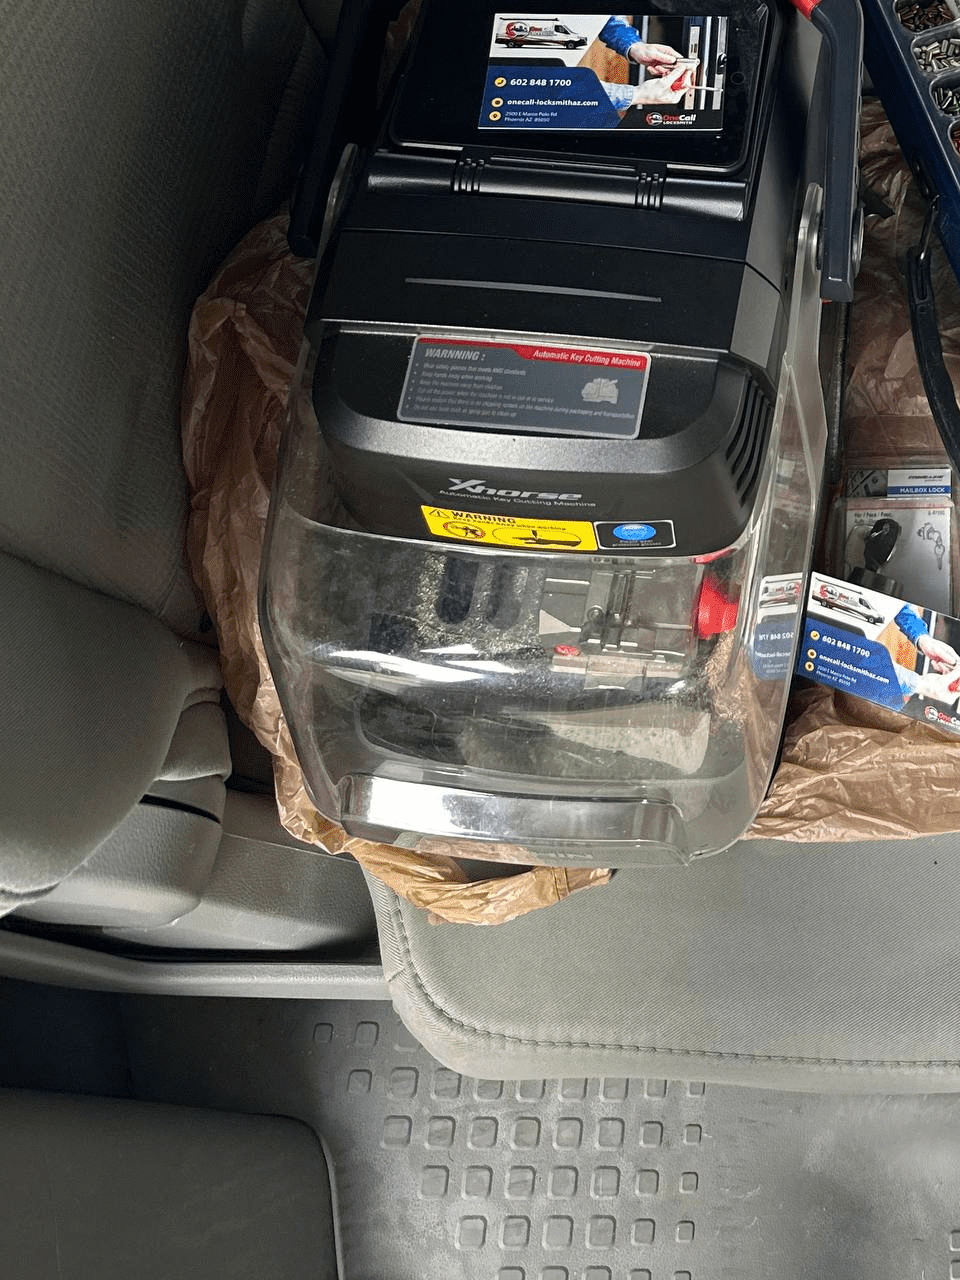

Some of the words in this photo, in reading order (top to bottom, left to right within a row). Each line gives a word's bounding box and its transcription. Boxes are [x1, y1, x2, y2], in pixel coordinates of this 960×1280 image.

[424, 347, 480, 361] WARNNING
[532, 349, 569, 361] Automatic
[569, 353, 584, 364] Key
[584, 353, 610, 366] Cutting
[611, 357, 641, 368] Machine
[439, 489, 491, 501] Automatic
[493, 496, 511, 505] Key
[513, 497, 552, 507] Cutting
[449, 477, 582, 501] Xhorse
[451, 511, 516, 524] WARNING
[822, 635, 836, 646] 602
[836, 640, 851, 651] 848
[852, 645, 871, 658] 1700
[819, 654, 890, 684] onecall-locksmithaz.com
